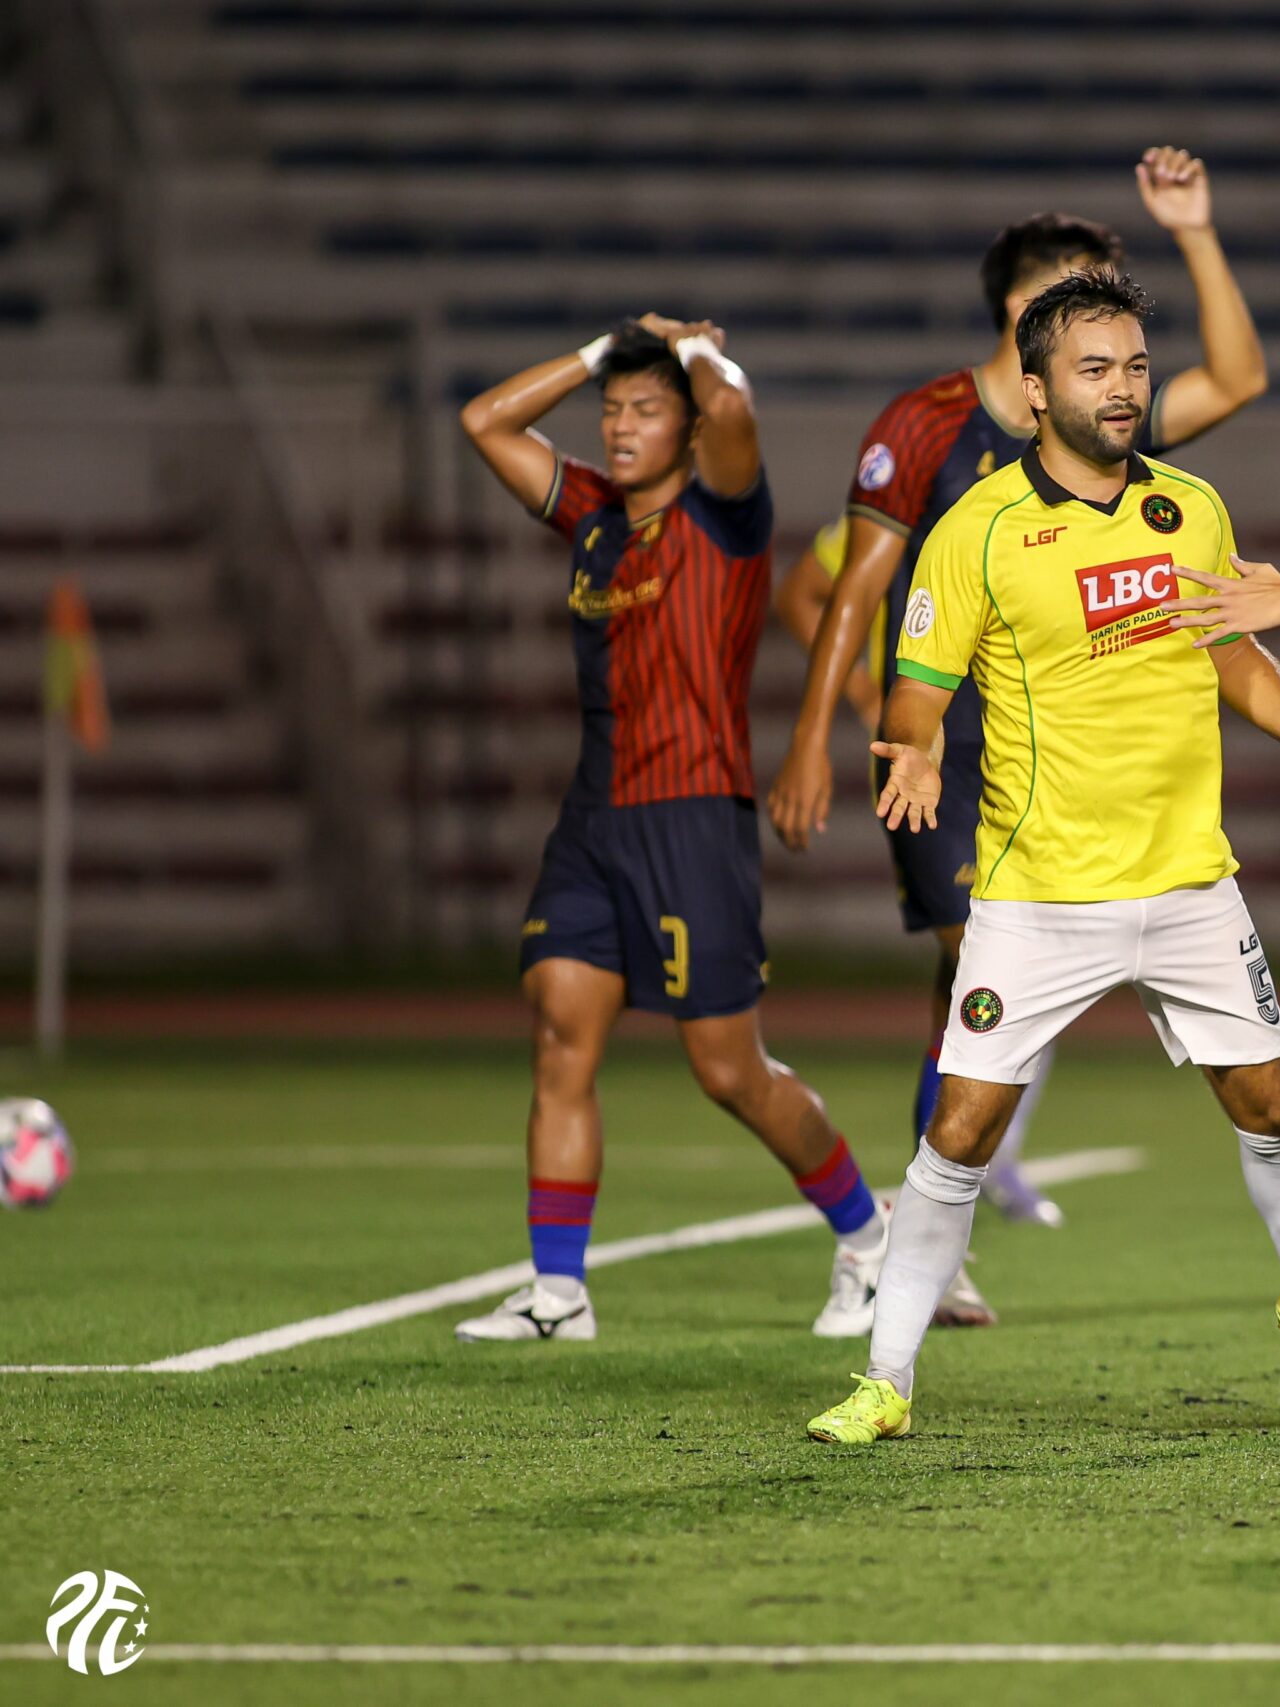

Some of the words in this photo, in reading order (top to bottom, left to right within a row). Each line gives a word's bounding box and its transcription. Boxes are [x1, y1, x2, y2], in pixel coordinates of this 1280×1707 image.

[1082, 563, 1171, 612] LBC
[1091, 625, 1114, 642] HARI
[1116, 619, 1131, 631] NG
[1133, 609, 1175, 625] PADAL
[659, 915, 689, 999] 3
[1246, 954, 1280, 1025] 5
